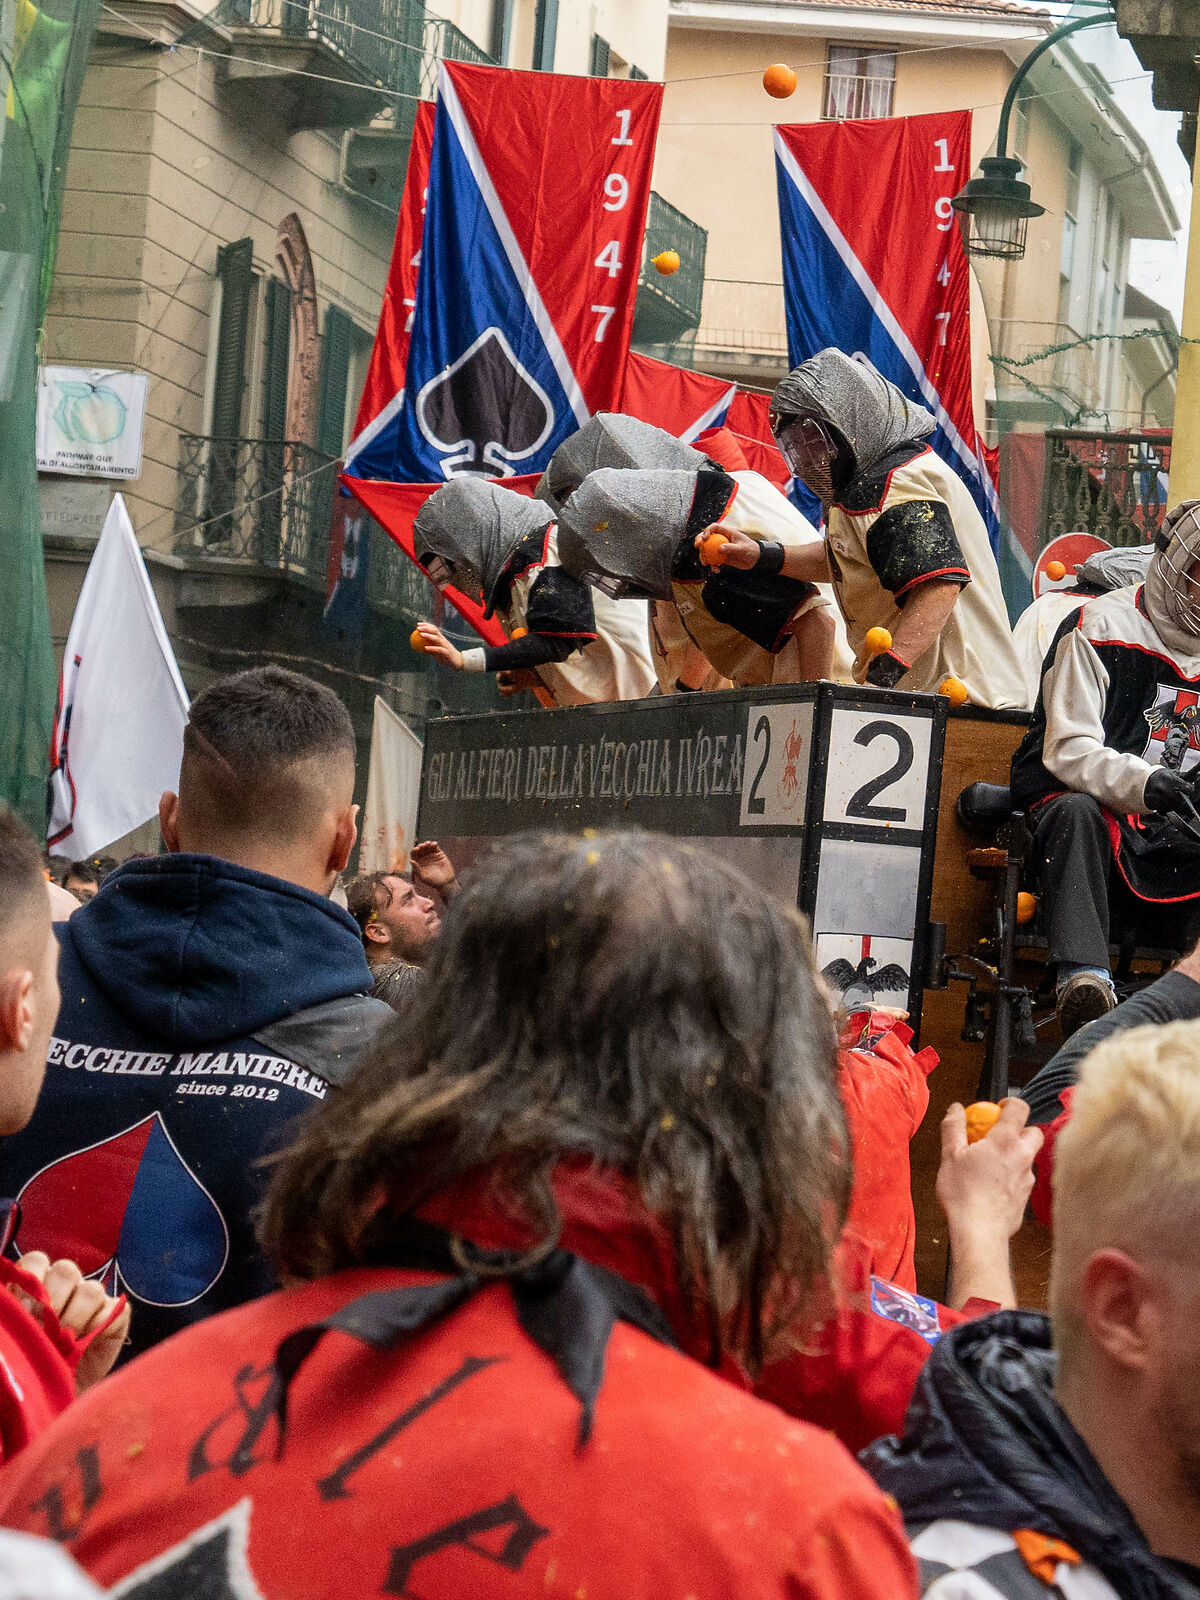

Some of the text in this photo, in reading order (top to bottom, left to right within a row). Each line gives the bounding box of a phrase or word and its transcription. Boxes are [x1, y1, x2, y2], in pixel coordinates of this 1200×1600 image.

[591, 109, 633, 342] 1947
[428, 727, 744, 804] GLI ALFIERI DELLA VECCHIA IVREA
[748, 715, 771, 814] 2
[845, 720, 914, 822] 2
[48, 1037, 173, 1076] ECCHIE
[176, 1080, 280, 1101] since 2012
